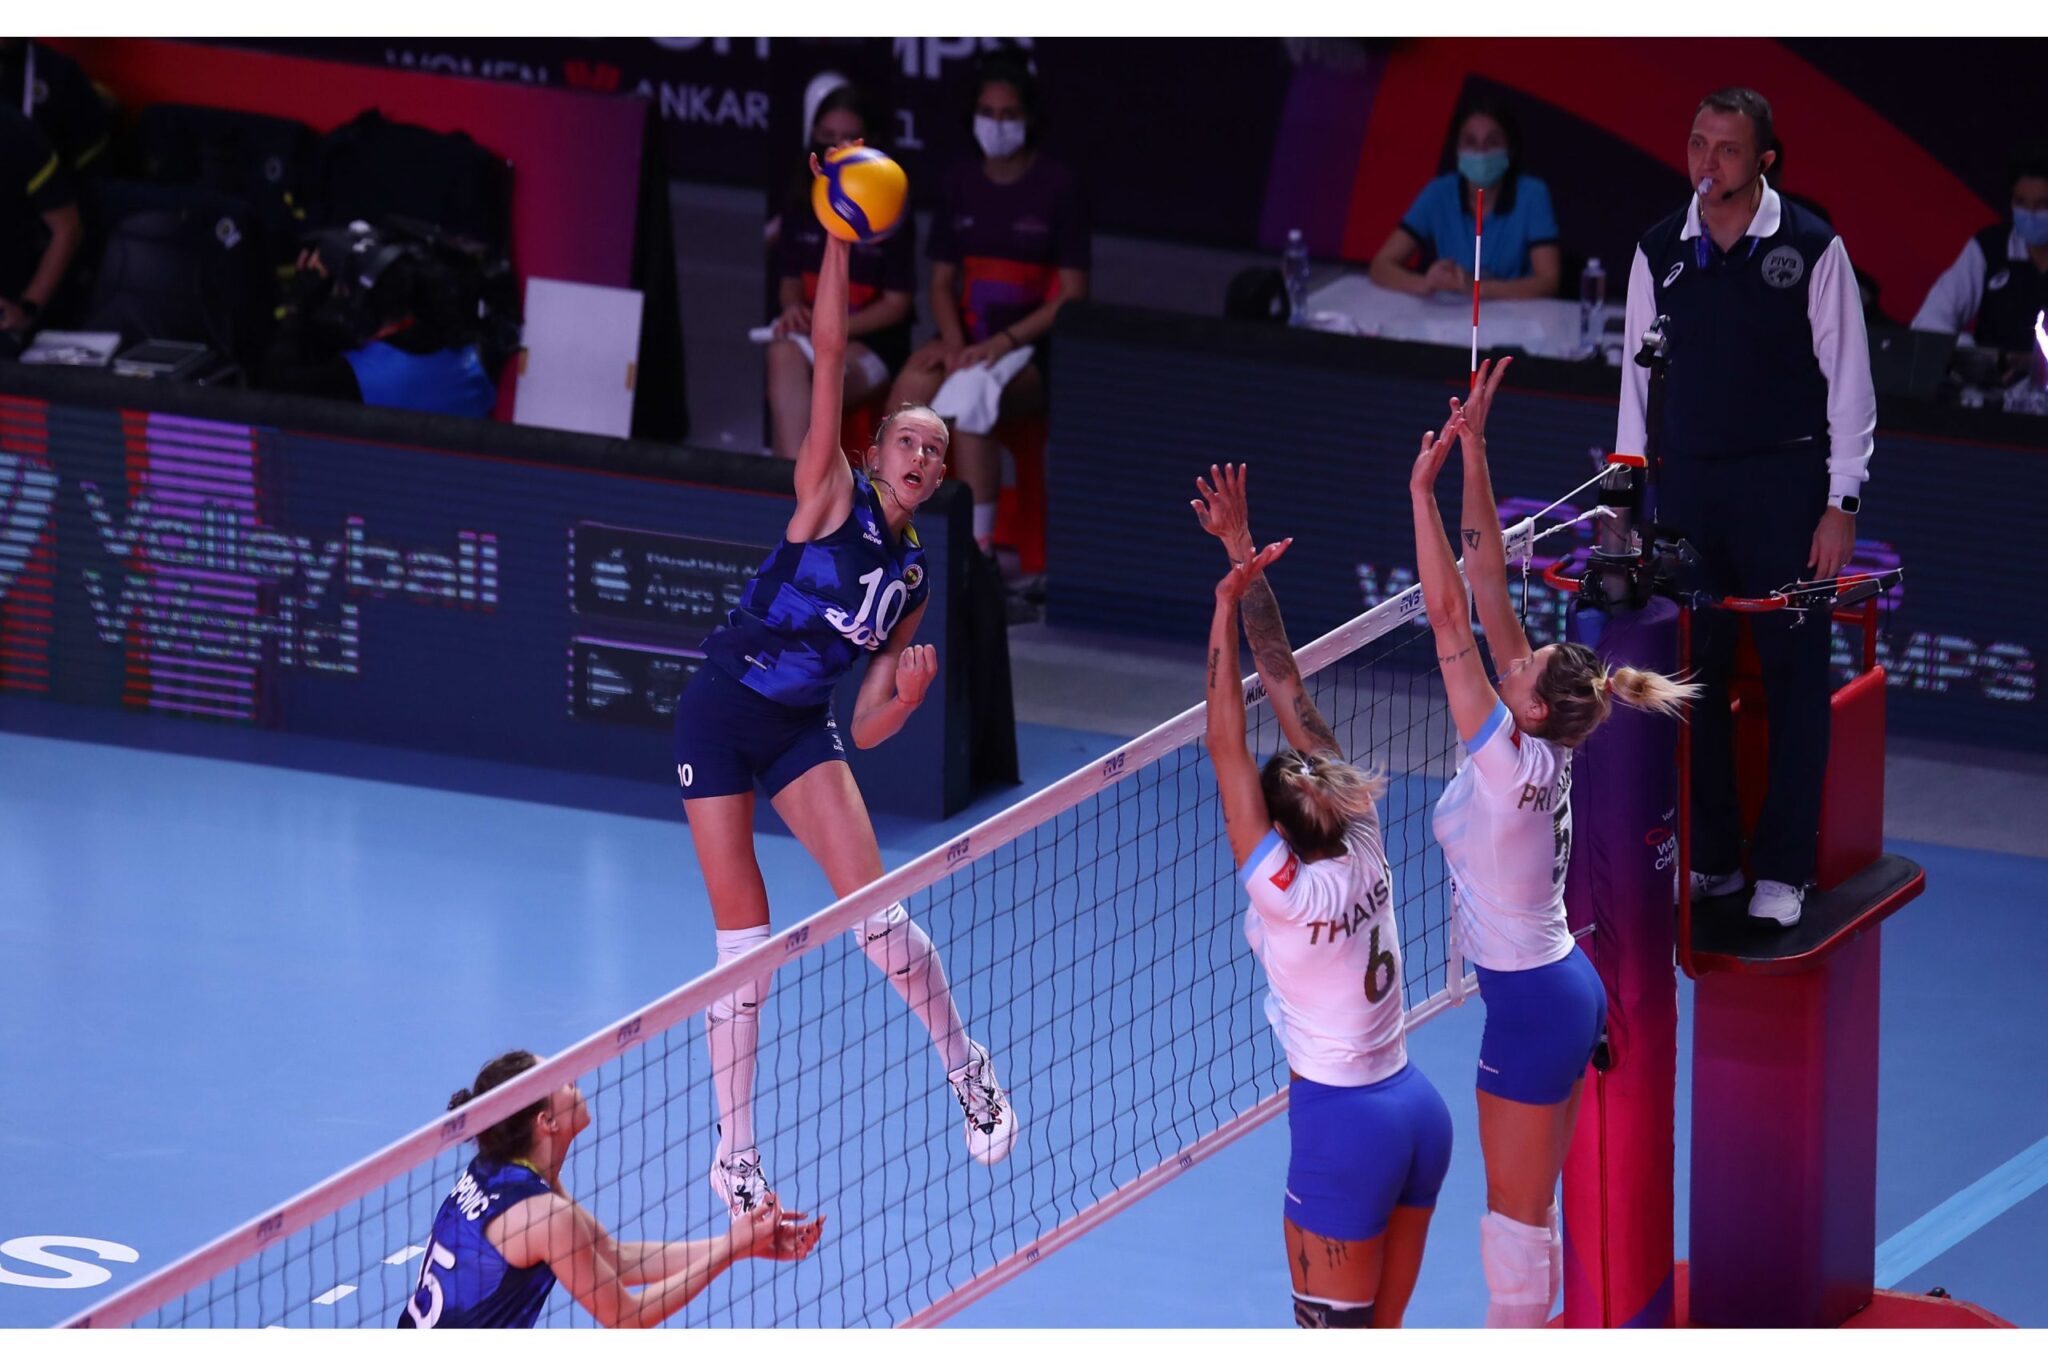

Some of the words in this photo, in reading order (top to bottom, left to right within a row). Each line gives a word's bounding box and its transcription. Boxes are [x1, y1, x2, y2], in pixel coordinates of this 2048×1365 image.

[1770, 255, 1797, 269] FIVB
[79, 479, 500, 608] Volleyball
[859, 567, 908, 641] 10
[678, 763, 693, 787] 10
[1364, 925, 1395, 1004] 6
